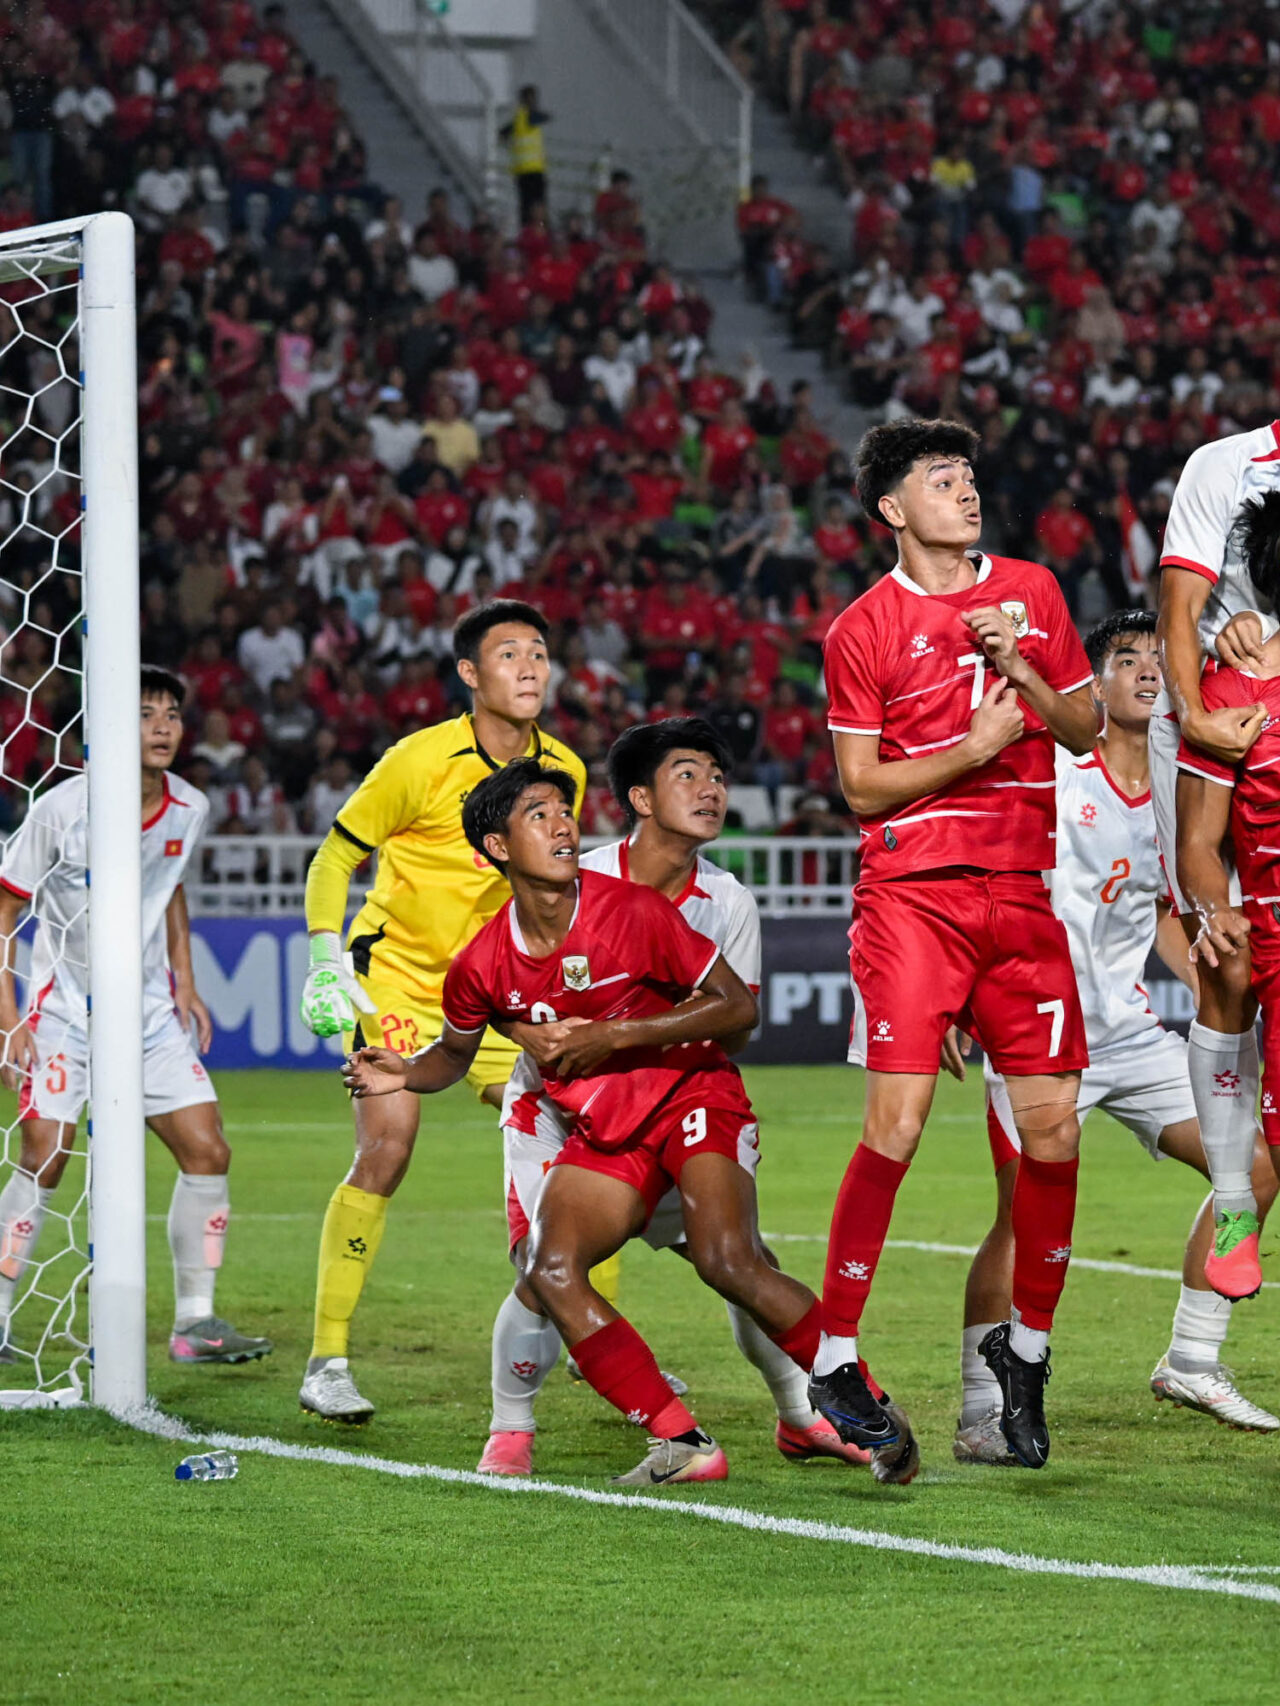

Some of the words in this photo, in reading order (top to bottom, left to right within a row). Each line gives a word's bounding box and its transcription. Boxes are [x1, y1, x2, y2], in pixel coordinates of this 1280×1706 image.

[910, 646, 935, 658] KELME
[957, 652, 985, 710] 7
[1100, 858, 1131, 904] 2
[1036, 999, 1065, 1058] 7
[46, 1053, 67, 1094] 5
[681, 1107, 707, 1147] 9
[838, 1267, 868, 1281] KELME
